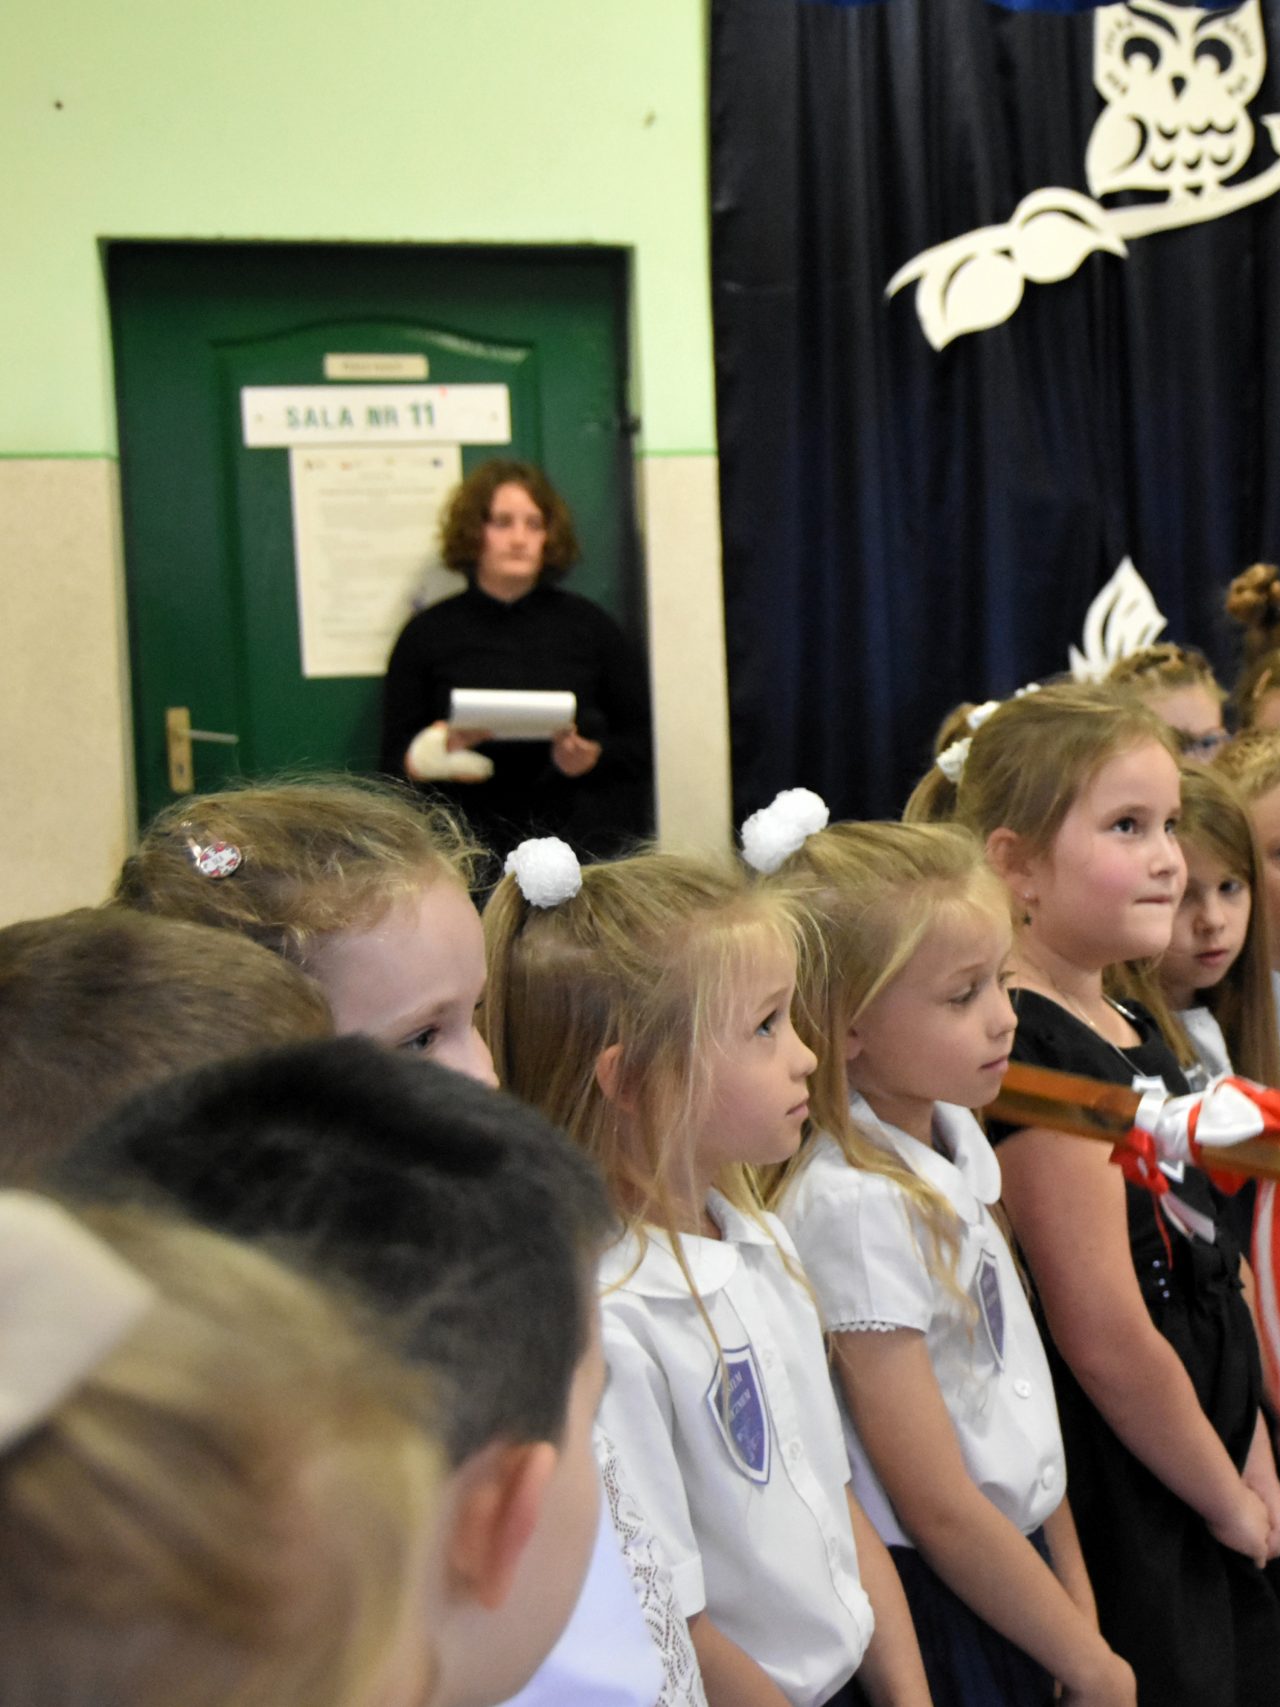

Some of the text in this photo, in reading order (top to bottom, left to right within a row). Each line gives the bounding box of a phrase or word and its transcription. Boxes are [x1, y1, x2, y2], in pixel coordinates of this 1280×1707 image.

[285, 400, 435, 430] SALA NR 11
